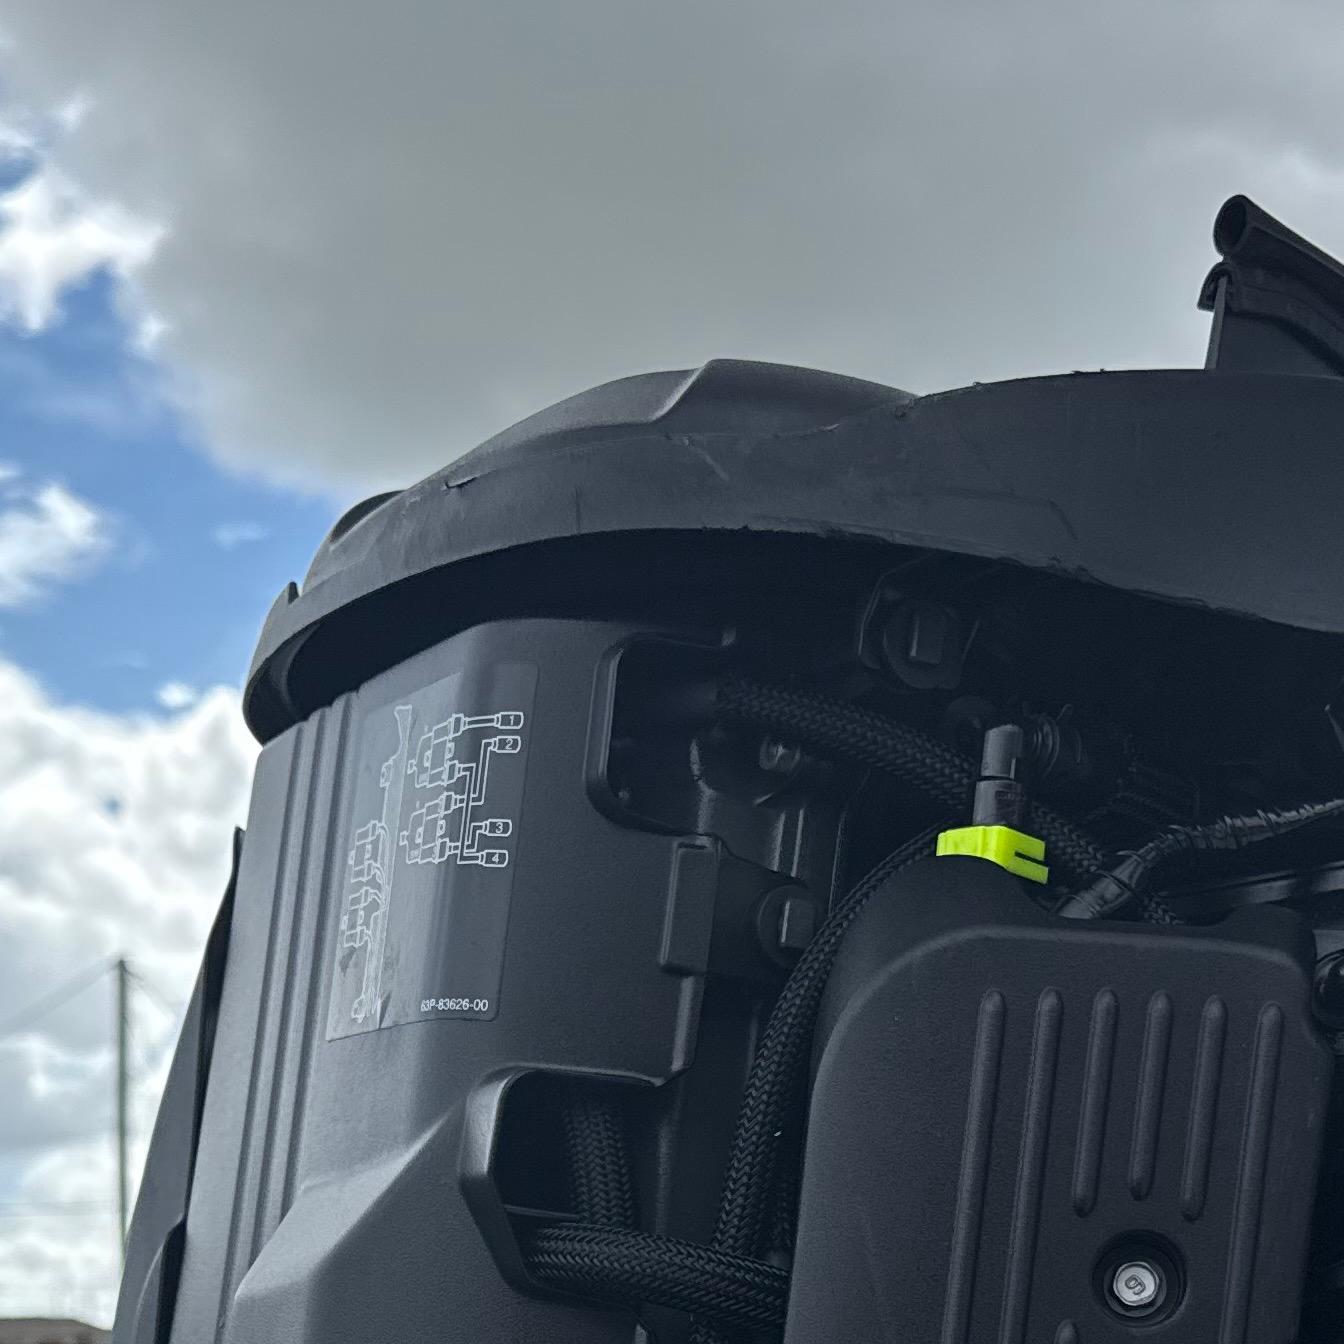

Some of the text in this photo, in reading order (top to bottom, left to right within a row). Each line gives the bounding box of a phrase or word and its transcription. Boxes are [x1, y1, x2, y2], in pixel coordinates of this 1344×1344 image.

[509, 714, 515, 726] 1
[505, 737, 514, 750] 2
[494, 821, 504, 834] 3
[491, 852, 500, 864] 4
[420, 998, 489, 1012] 63P-83626-00
